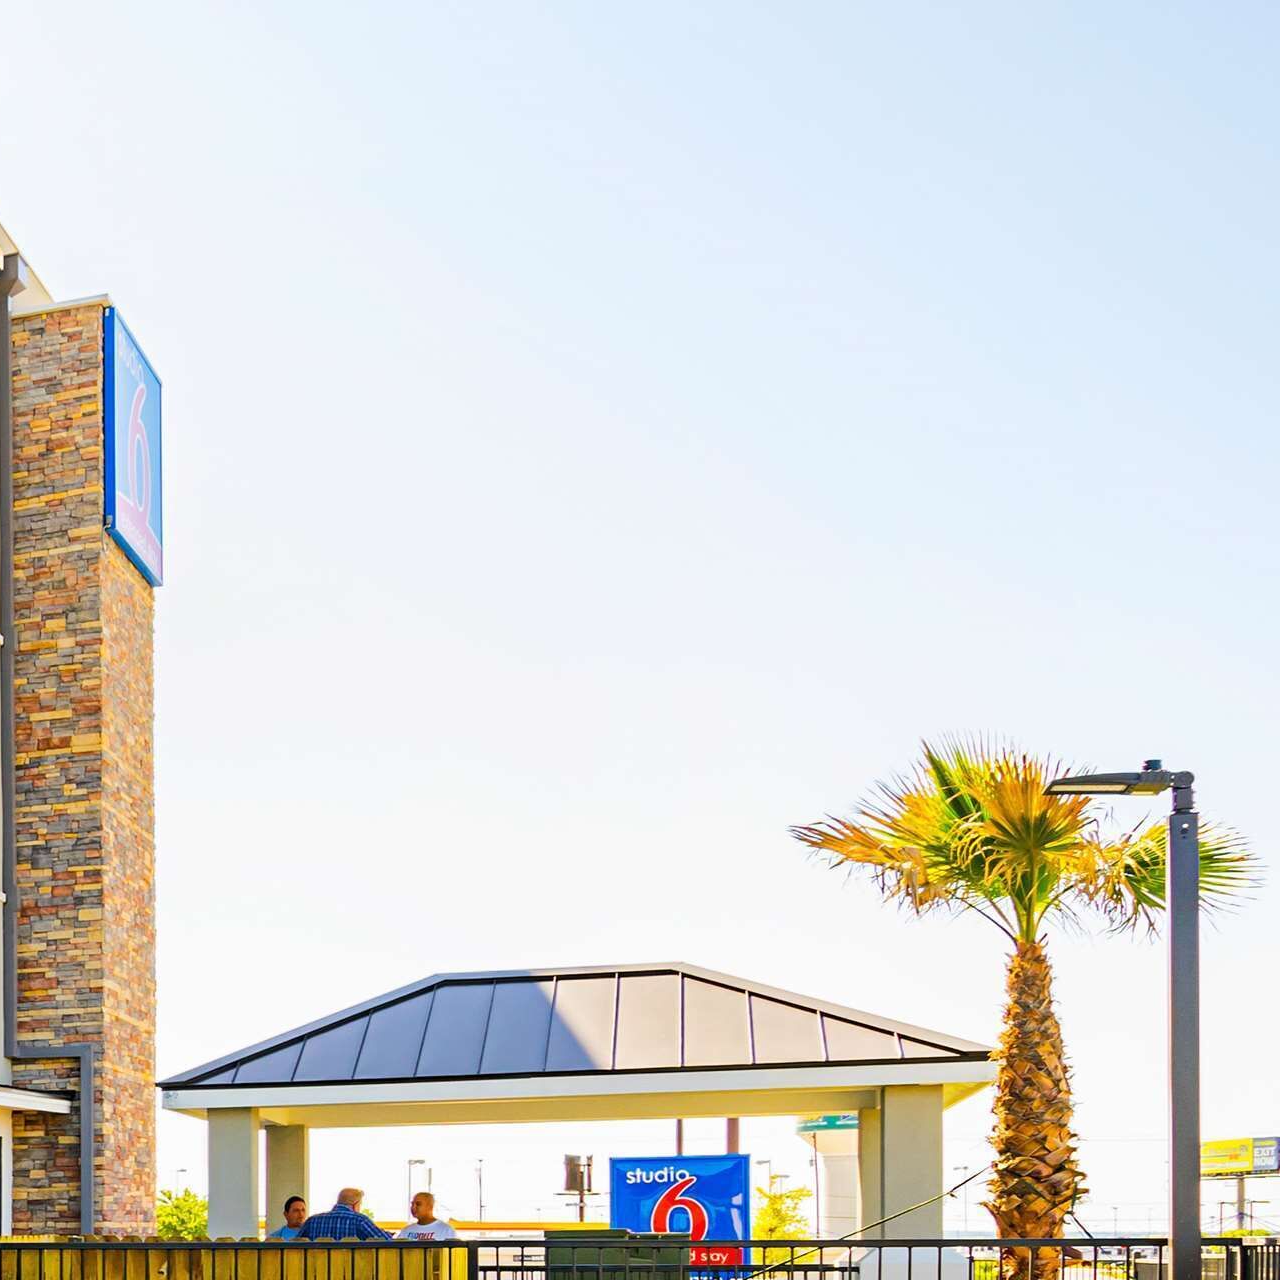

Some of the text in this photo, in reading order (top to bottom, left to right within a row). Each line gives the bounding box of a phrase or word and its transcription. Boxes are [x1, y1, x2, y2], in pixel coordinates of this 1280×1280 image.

[626, 1166, 690, 1184] studio
[650, 1175, 709, 1241] 6
[700, 1250, 730, 1265] say
